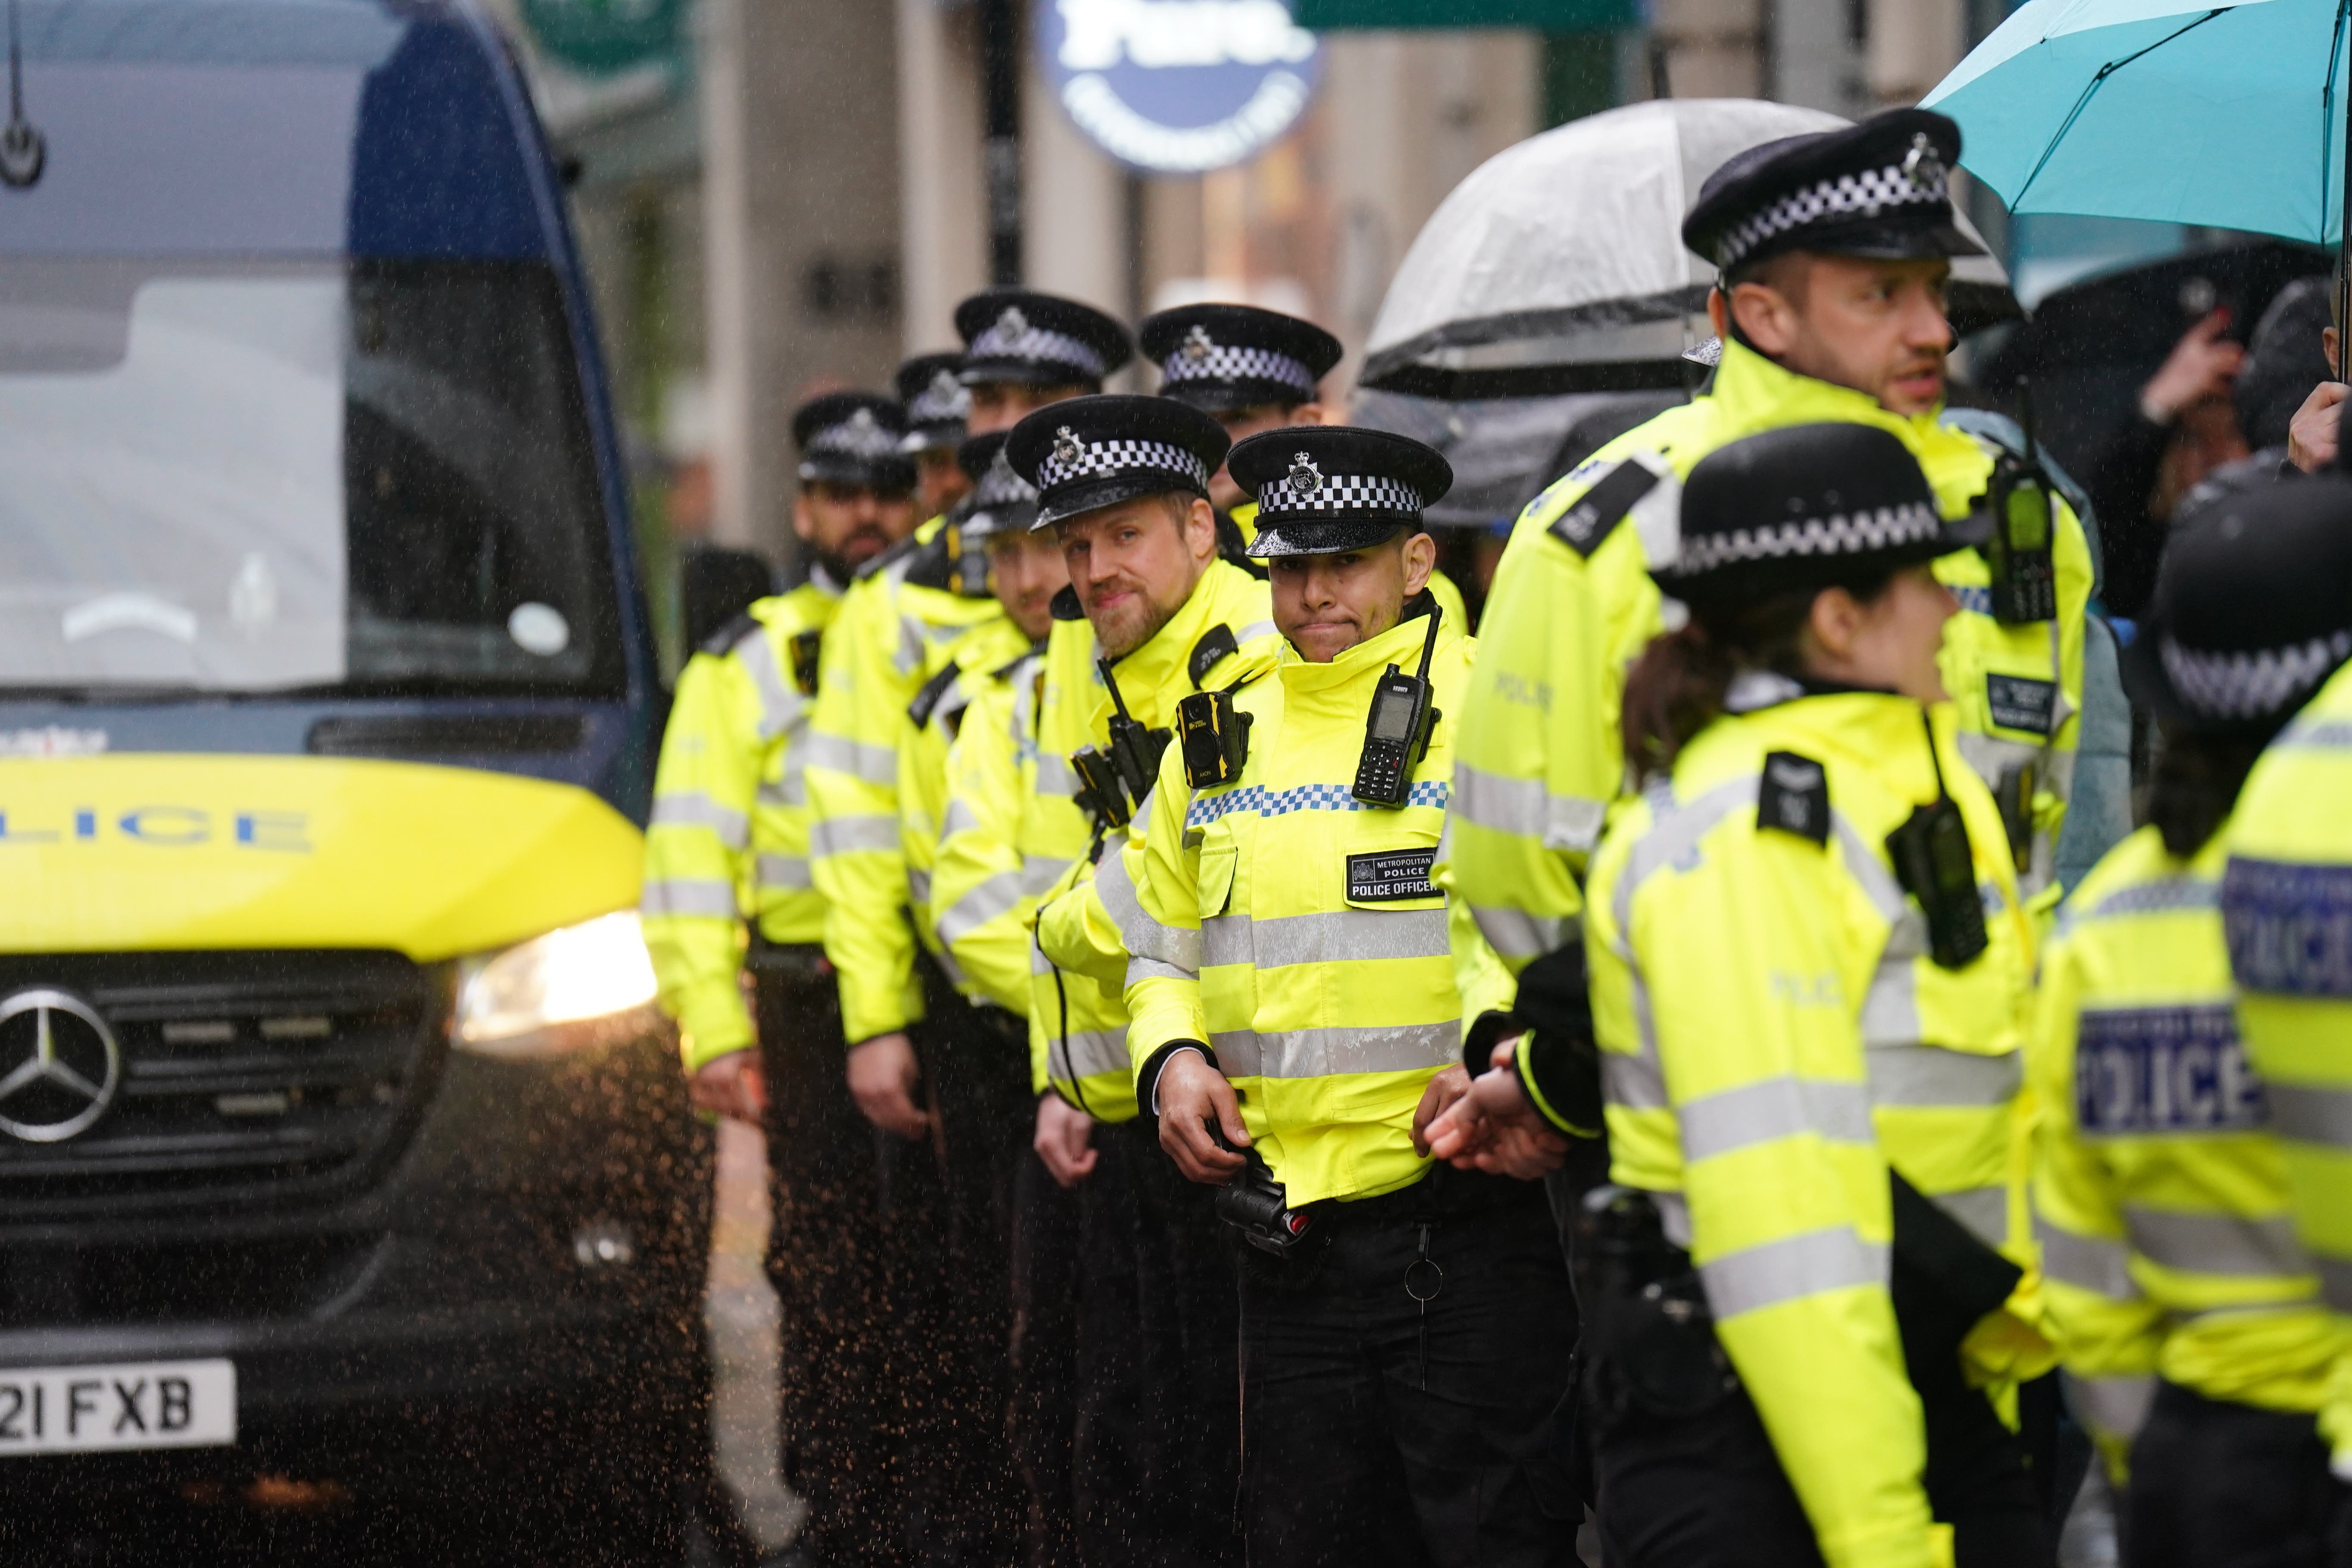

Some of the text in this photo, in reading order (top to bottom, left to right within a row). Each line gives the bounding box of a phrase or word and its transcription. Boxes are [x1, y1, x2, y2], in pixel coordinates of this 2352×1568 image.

[1377, 857, 1431, 868] METROPOLITAN
[1384, 867, 1425, 878] POLICE
[1352, 883, 1391, 896] POLICE
[67, 1379, 193, 1437] FXB
